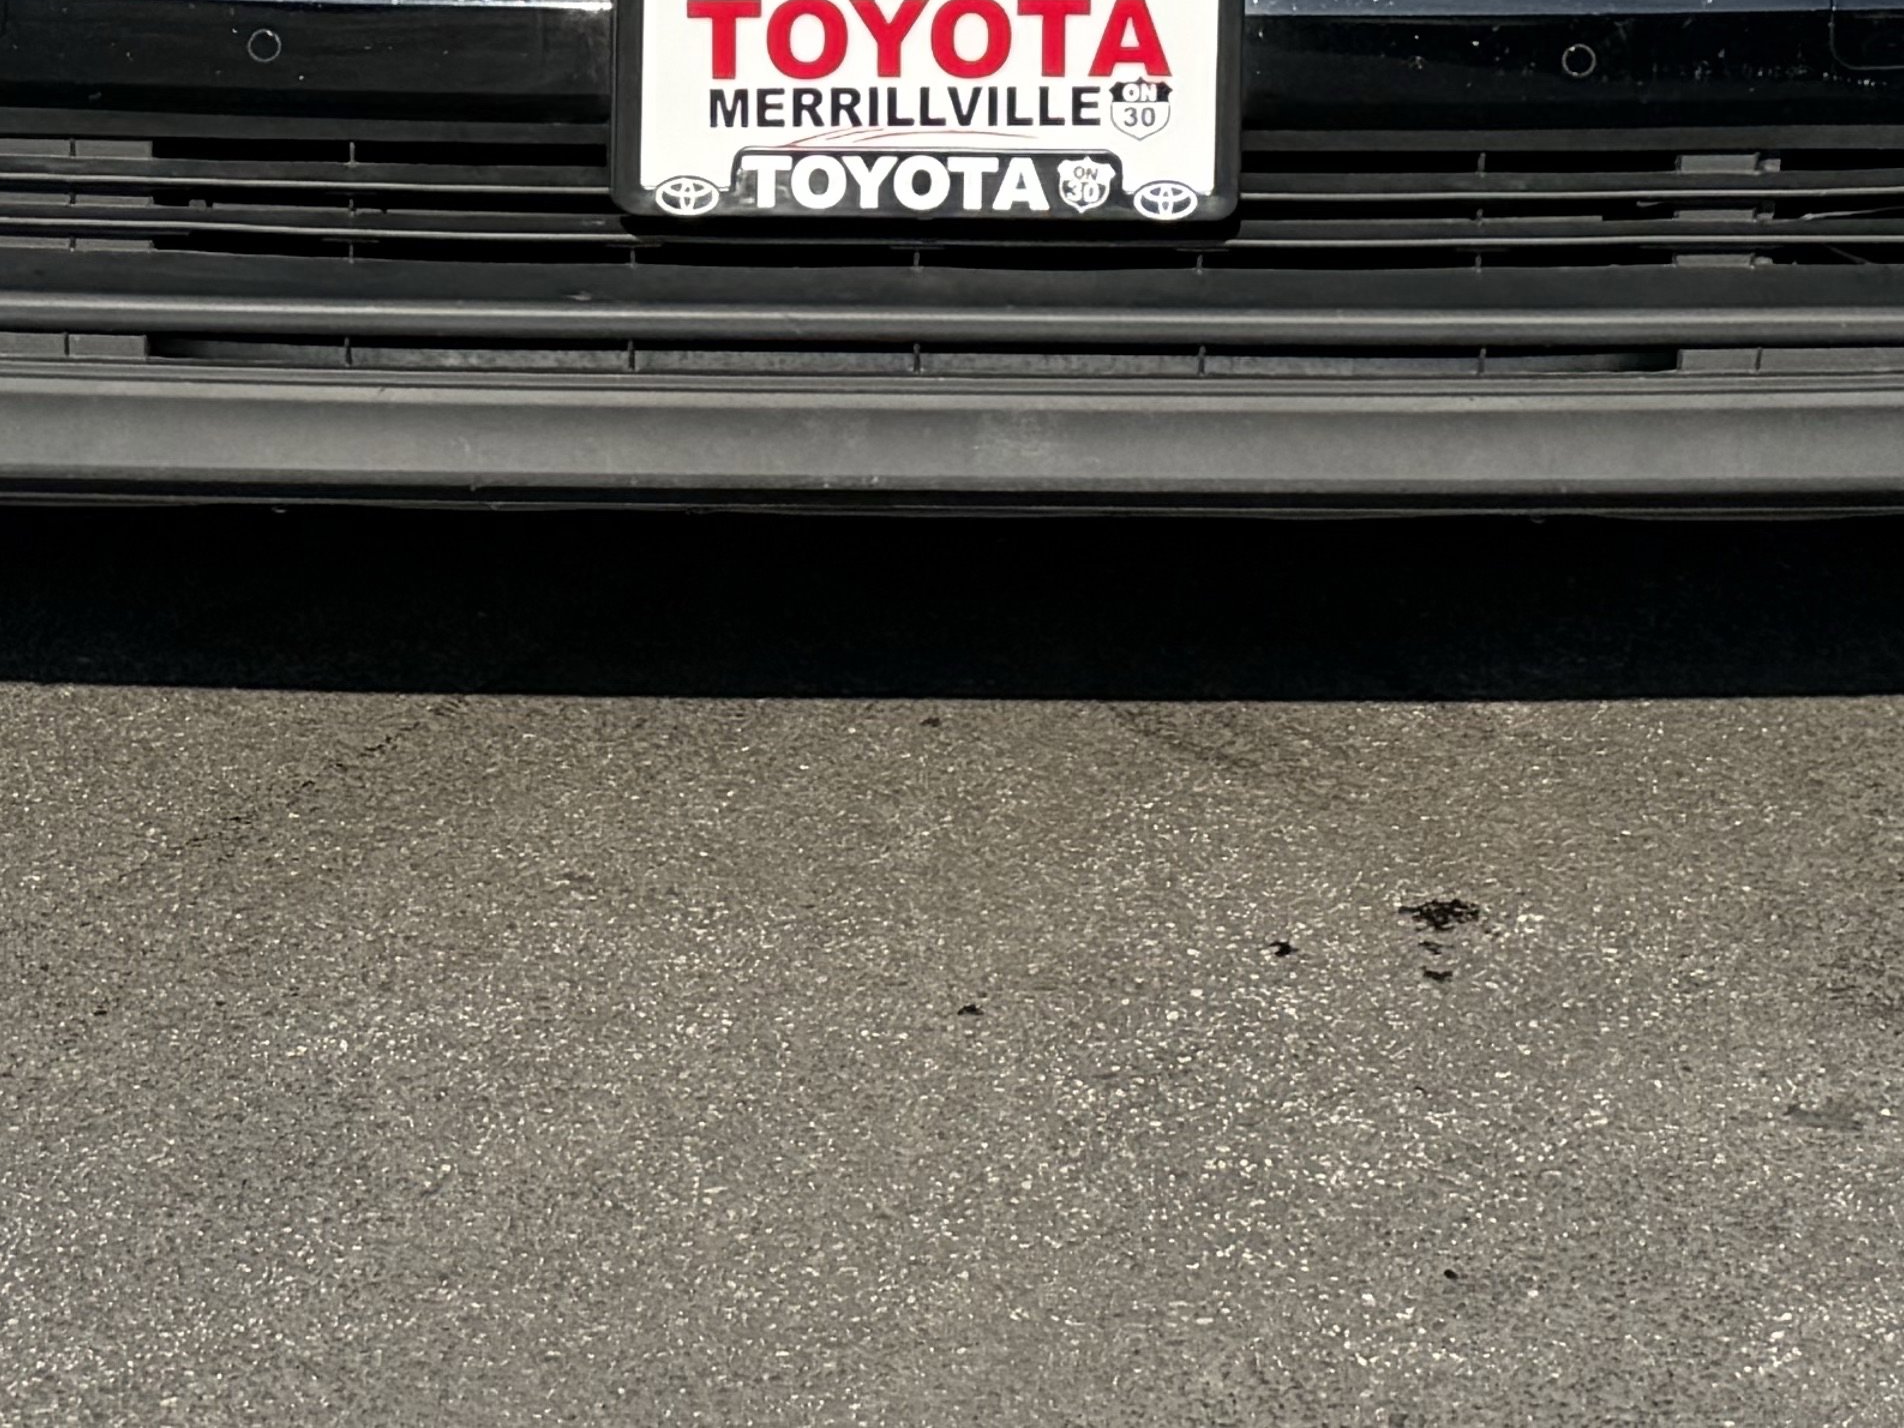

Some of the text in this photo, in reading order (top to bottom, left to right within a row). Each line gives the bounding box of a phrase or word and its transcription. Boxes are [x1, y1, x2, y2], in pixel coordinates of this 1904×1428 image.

[1122, 83, 1158, 103] ON
[708, 85, 1102, 128] MERRILLVILLE
[1123, 106, 1157, 128] 30
[741, 153, 1050, 212] TOYOTA
[1073, 165, 1098, 180] ON
[1064, 180, 1100, 203] 30
